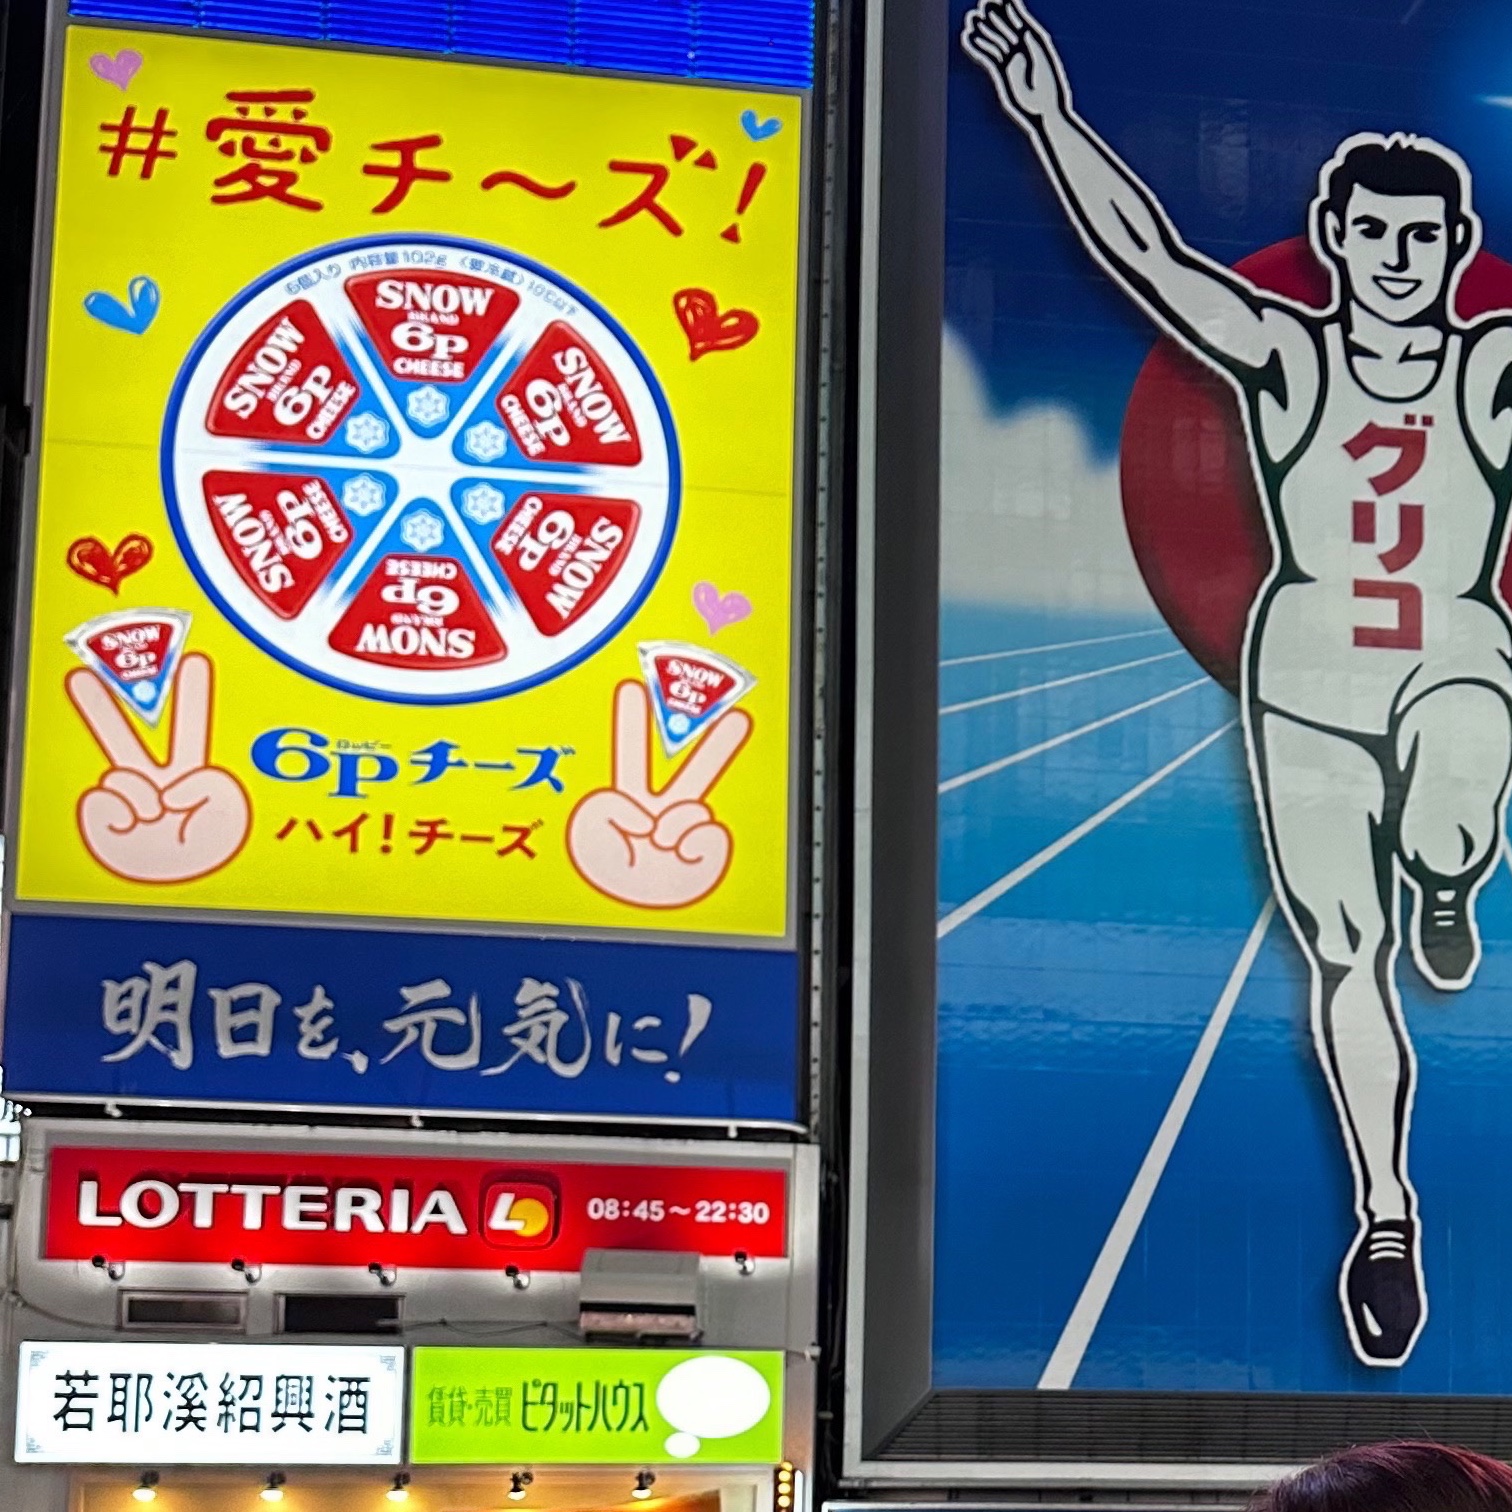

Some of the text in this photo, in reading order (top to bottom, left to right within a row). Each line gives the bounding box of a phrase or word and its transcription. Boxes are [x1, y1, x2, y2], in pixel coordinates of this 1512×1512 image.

[374, 279, 496, 317] SNOW
[222, 316, 306, 420] SNOW
[390, 321, 470, 361] 6P
[392, 357, 465, 380] CHEESE
[272, 364, 334, 426] 6P
[305, 380, 357, 440] CHEESE
[500, 393, 547, 458] CHEESE
[524, 377, 571, 448] 6P
[551, 346, 632, 445] SNOW
[276, 489, 324, 560] 6P
[301, 479, 350, 544] CHEESE
[494, 496, 543, 557] CHEESE
[517, 509, 576, 572] 6P
[1341, 413, 1435, 651] グリコ
[211, 492, 296, 594] SNOW
[383, 558, 458, 580] CHEESE
[545, 516, 624, 621] SNOW
[381, 576, 461, 617] 6P
[101, 624, 161, 651] SNOW
[353, 623, 477, 660] SNOW
[666, 659, 725, 690] SNOW
[77, 1179, 469, 1236] LOTTERIA
[520, 1377, 650, 1433] ピタットハウス
